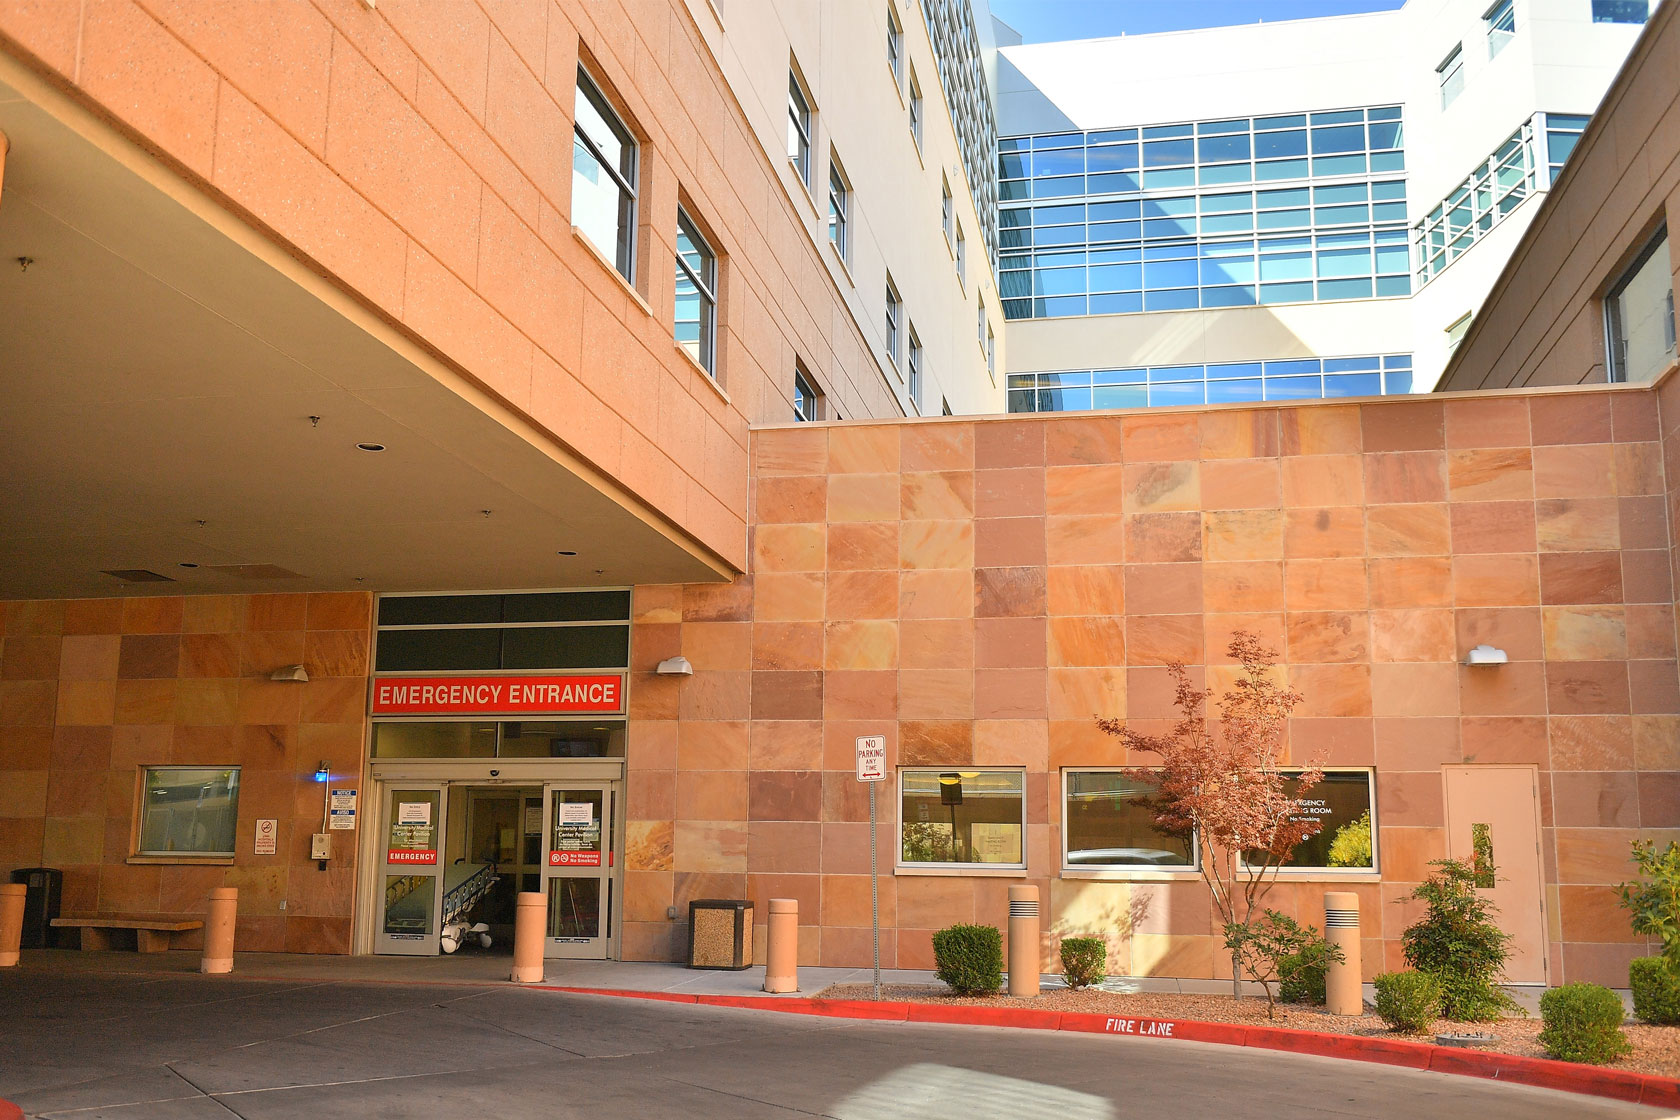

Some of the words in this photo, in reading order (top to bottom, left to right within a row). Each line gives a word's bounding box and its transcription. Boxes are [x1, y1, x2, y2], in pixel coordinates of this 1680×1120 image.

[379, 685, 503, 705] EMERGENCY
[508, 683, 615, 704] ENTRANCE
[865, 739, 876, 748] NO
[858, 749, 884, 758] PARKING
[1105, 1018, 1136, 1033] FIRE
[1139, 1020, 1175, 1036] LANE
